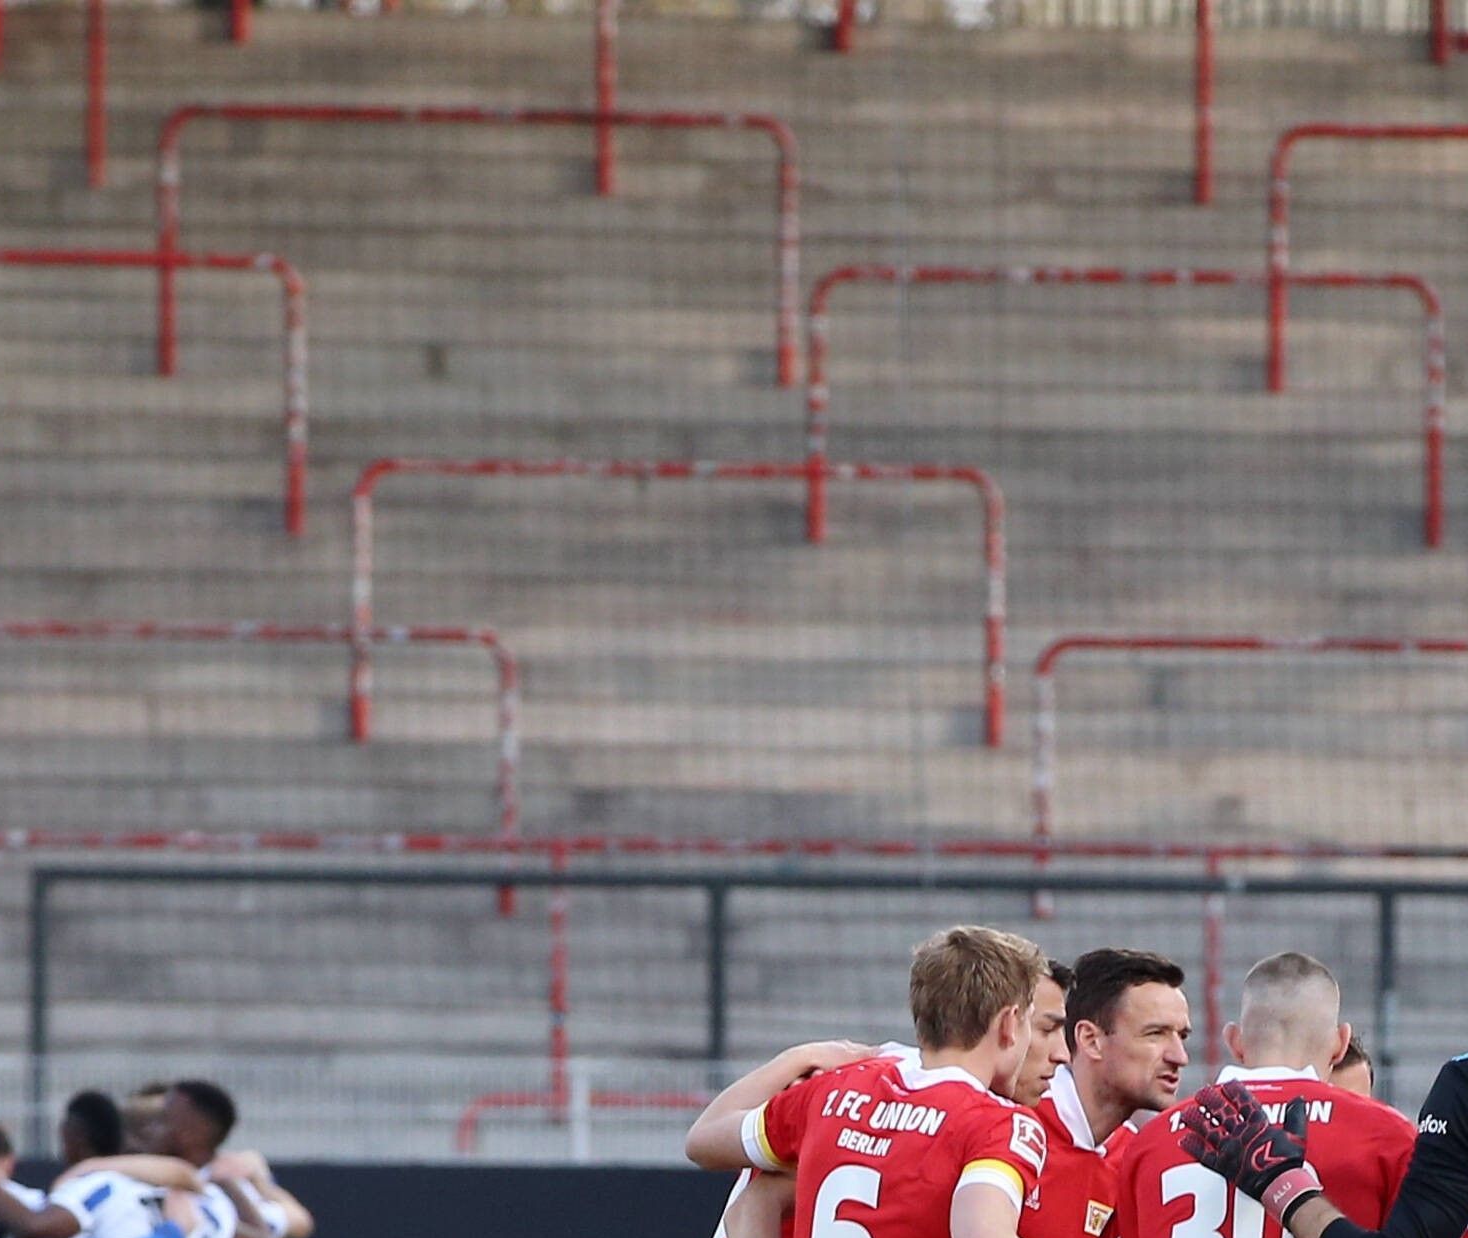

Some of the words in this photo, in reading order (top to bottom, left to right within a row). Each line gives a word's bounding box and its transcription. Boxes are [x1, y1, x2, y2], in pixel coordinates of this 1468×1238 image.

[822, 1089, 834, 1117] 1.
[836, 1090, 872, 1121] FC
[868, 1101, 947, 1136] UNION
[837, 1128, 893, 1157] BERLIN
[1272, 1182, 1292, 1204] ALU
